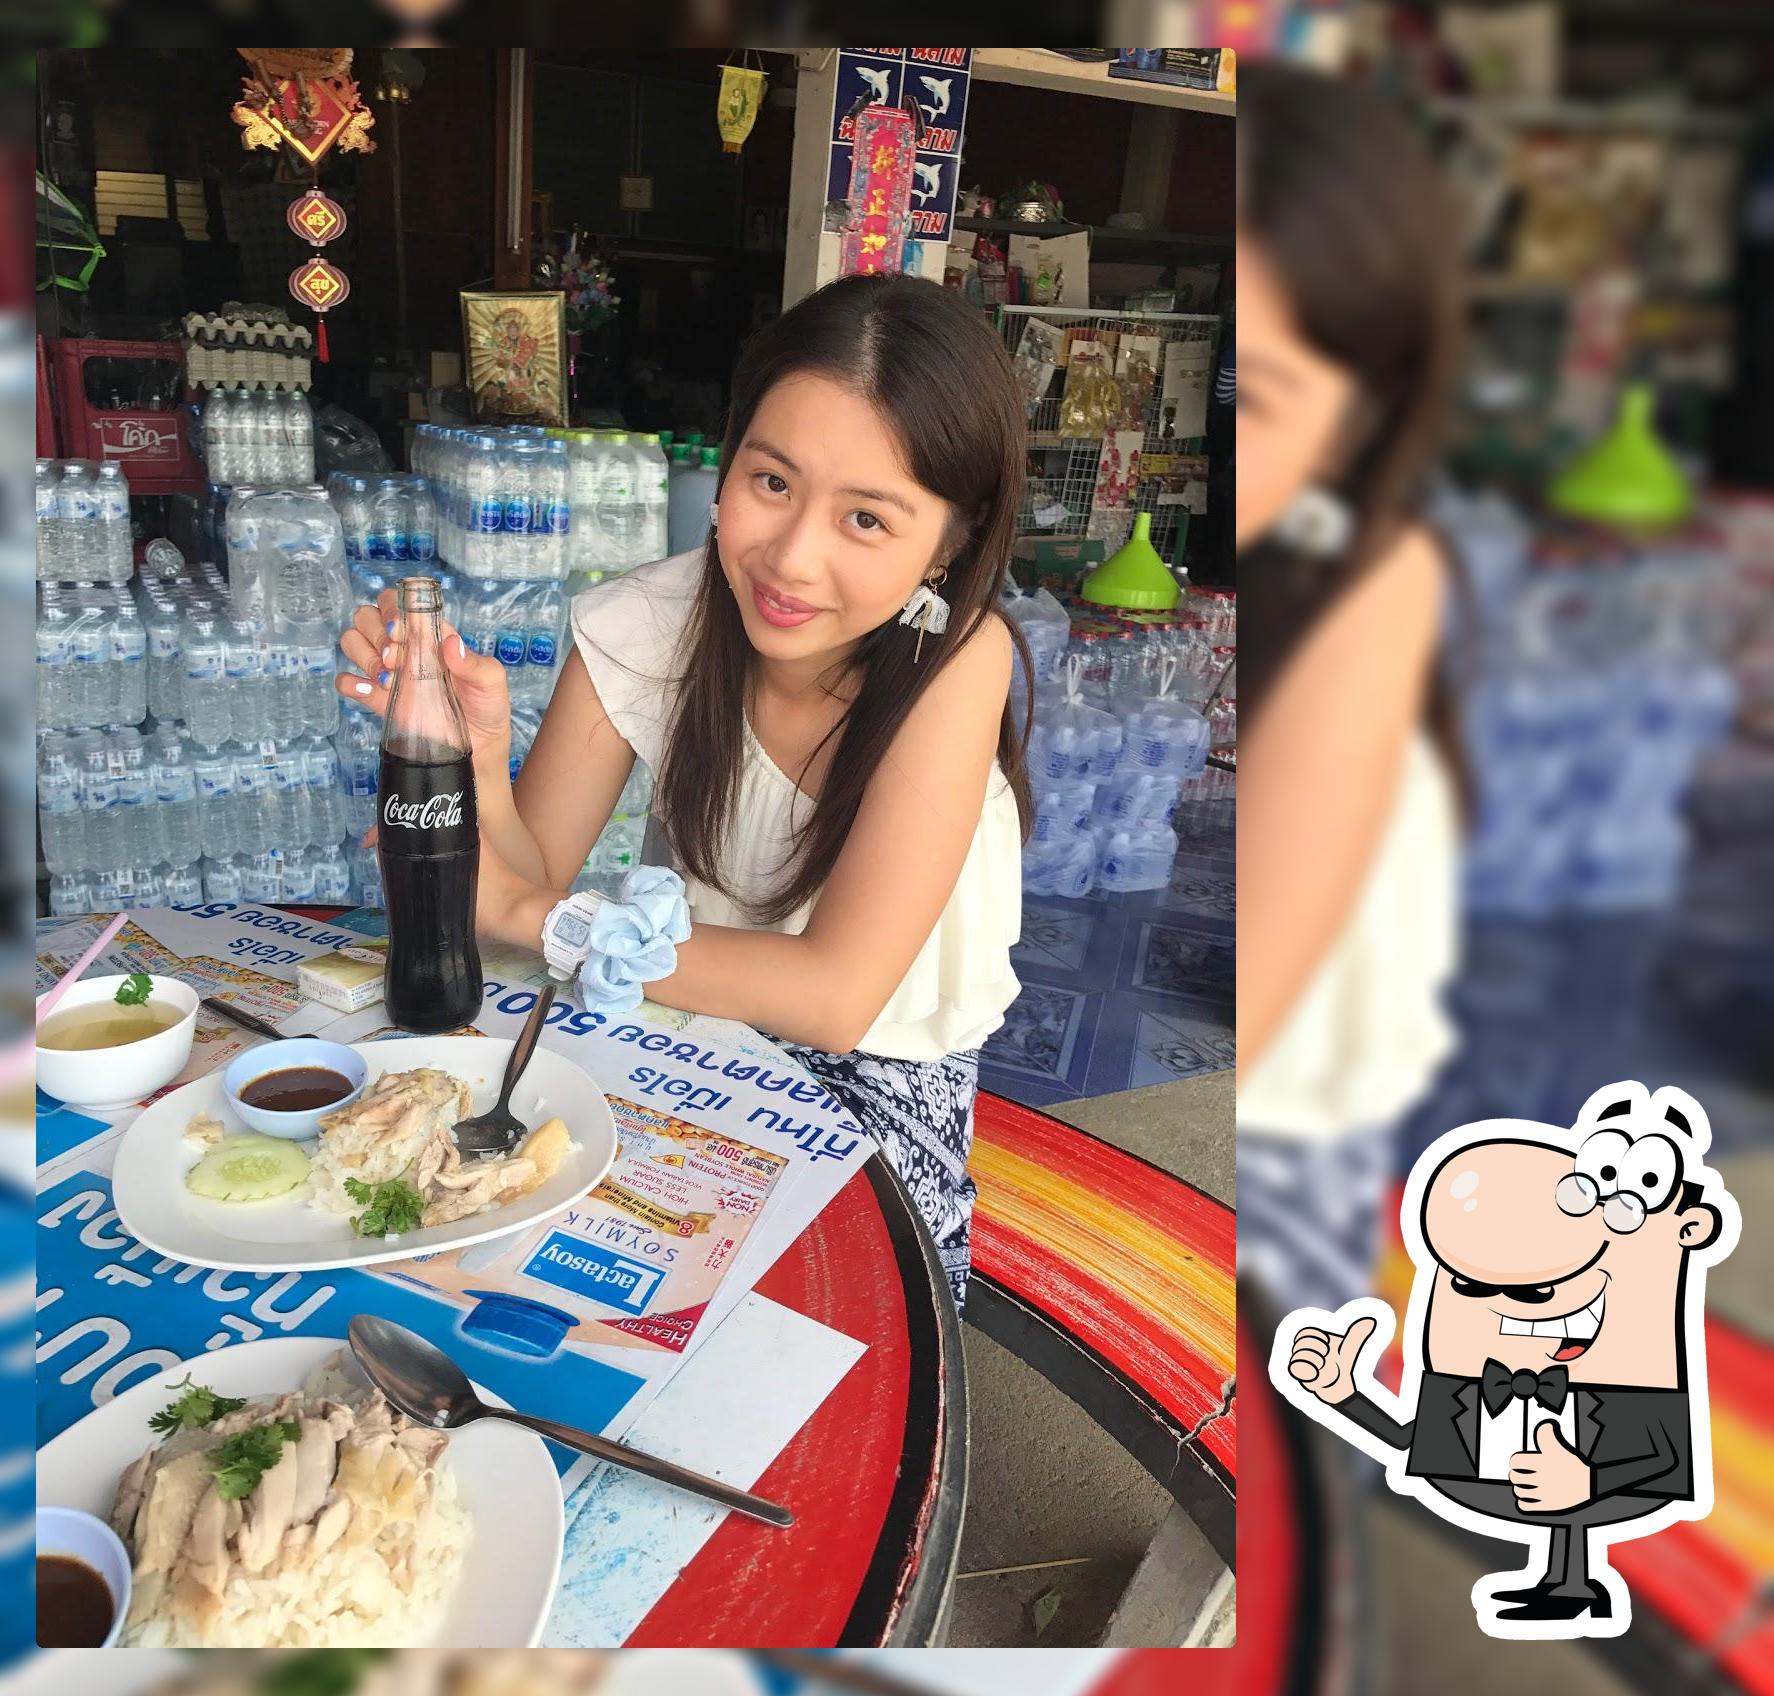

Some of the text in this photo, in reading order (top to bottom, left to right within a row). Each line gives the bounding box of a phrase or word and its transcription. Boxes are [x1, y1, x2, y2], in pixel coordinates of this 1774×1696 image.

[916, 126, 957, 151] ลาม
[383, 790, 464, 830] Coca-Cola
[628, 1066, 859, 1162] ที่ไหน เมื่อไร
[716, 1144, 742, 1161] 500
[628, 1159, 701, 1188] VEGETARIAN FORMULA
[689, 1161, 726, 1177] PROTEIN
[694, 1153, 769, 1182] NATURAL WHOLE SOYBEAN
[620, 1175, 688, 1204] HIGH CALCIUM
[633, 1170, 686, 1192] LESS SUGAR
[604, 1193, 664, 1227] Contain More than
[632, 1200, 647, 1210] and
[726, 1201, 748, 1211] NON
[730, 1196, 749, 1205] DAIRY
[677, 1221, 693, 1234] 8
[710, 1239, 734, 1268] 力大
[542, 1247, 656, 1304] Lactasoy
[616, 1318, 685, 1344] HEALTHY
[650, 1313, 692, 1329] CHOICE
